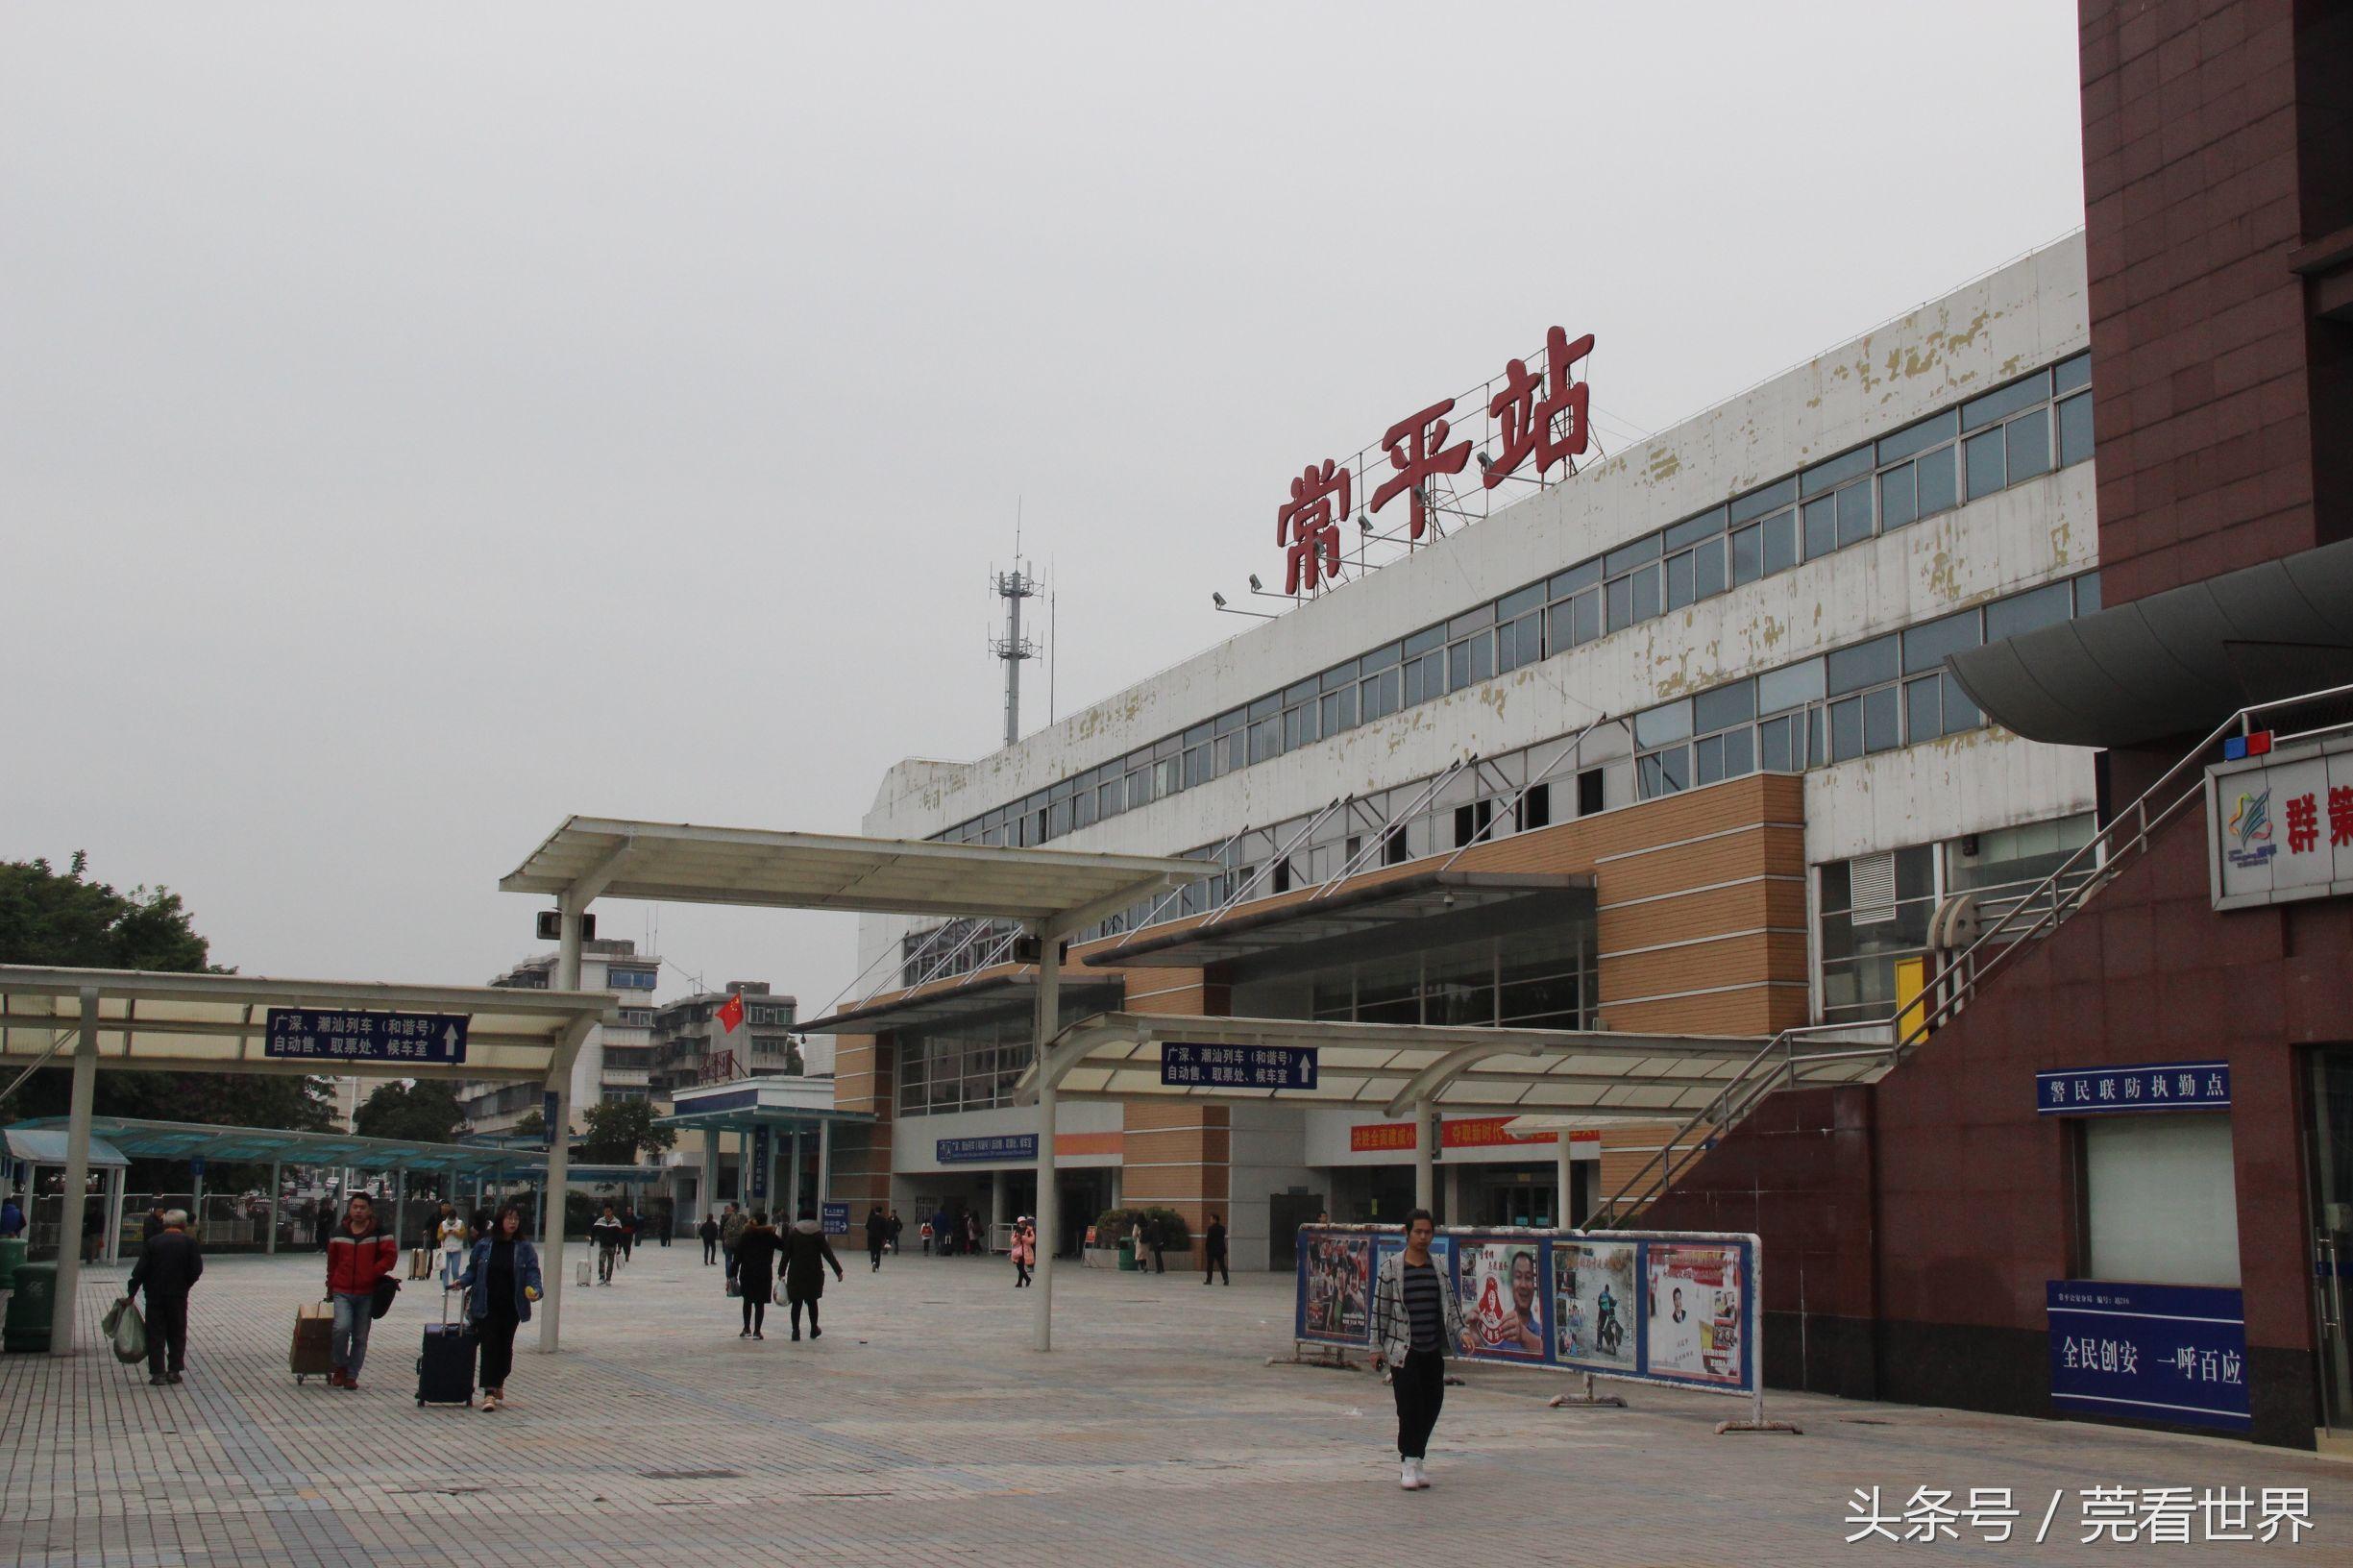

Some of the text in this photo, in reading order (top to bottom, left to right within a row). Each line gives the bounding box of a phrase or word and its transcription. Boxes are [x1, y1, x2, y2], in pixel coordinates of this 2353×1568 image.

[1277, 326, 1595, 595] 常平站
[273, 1035, 429, 1057] 自动售、取票处、候车室
[1167, 1066, 1287, 1084] 自动售、取票处、候车室
[2050, 1072, 2224, 1103] 警民联防执勤点
[2062, 1335, 2243, 1384] 全民创安 一呼百应
